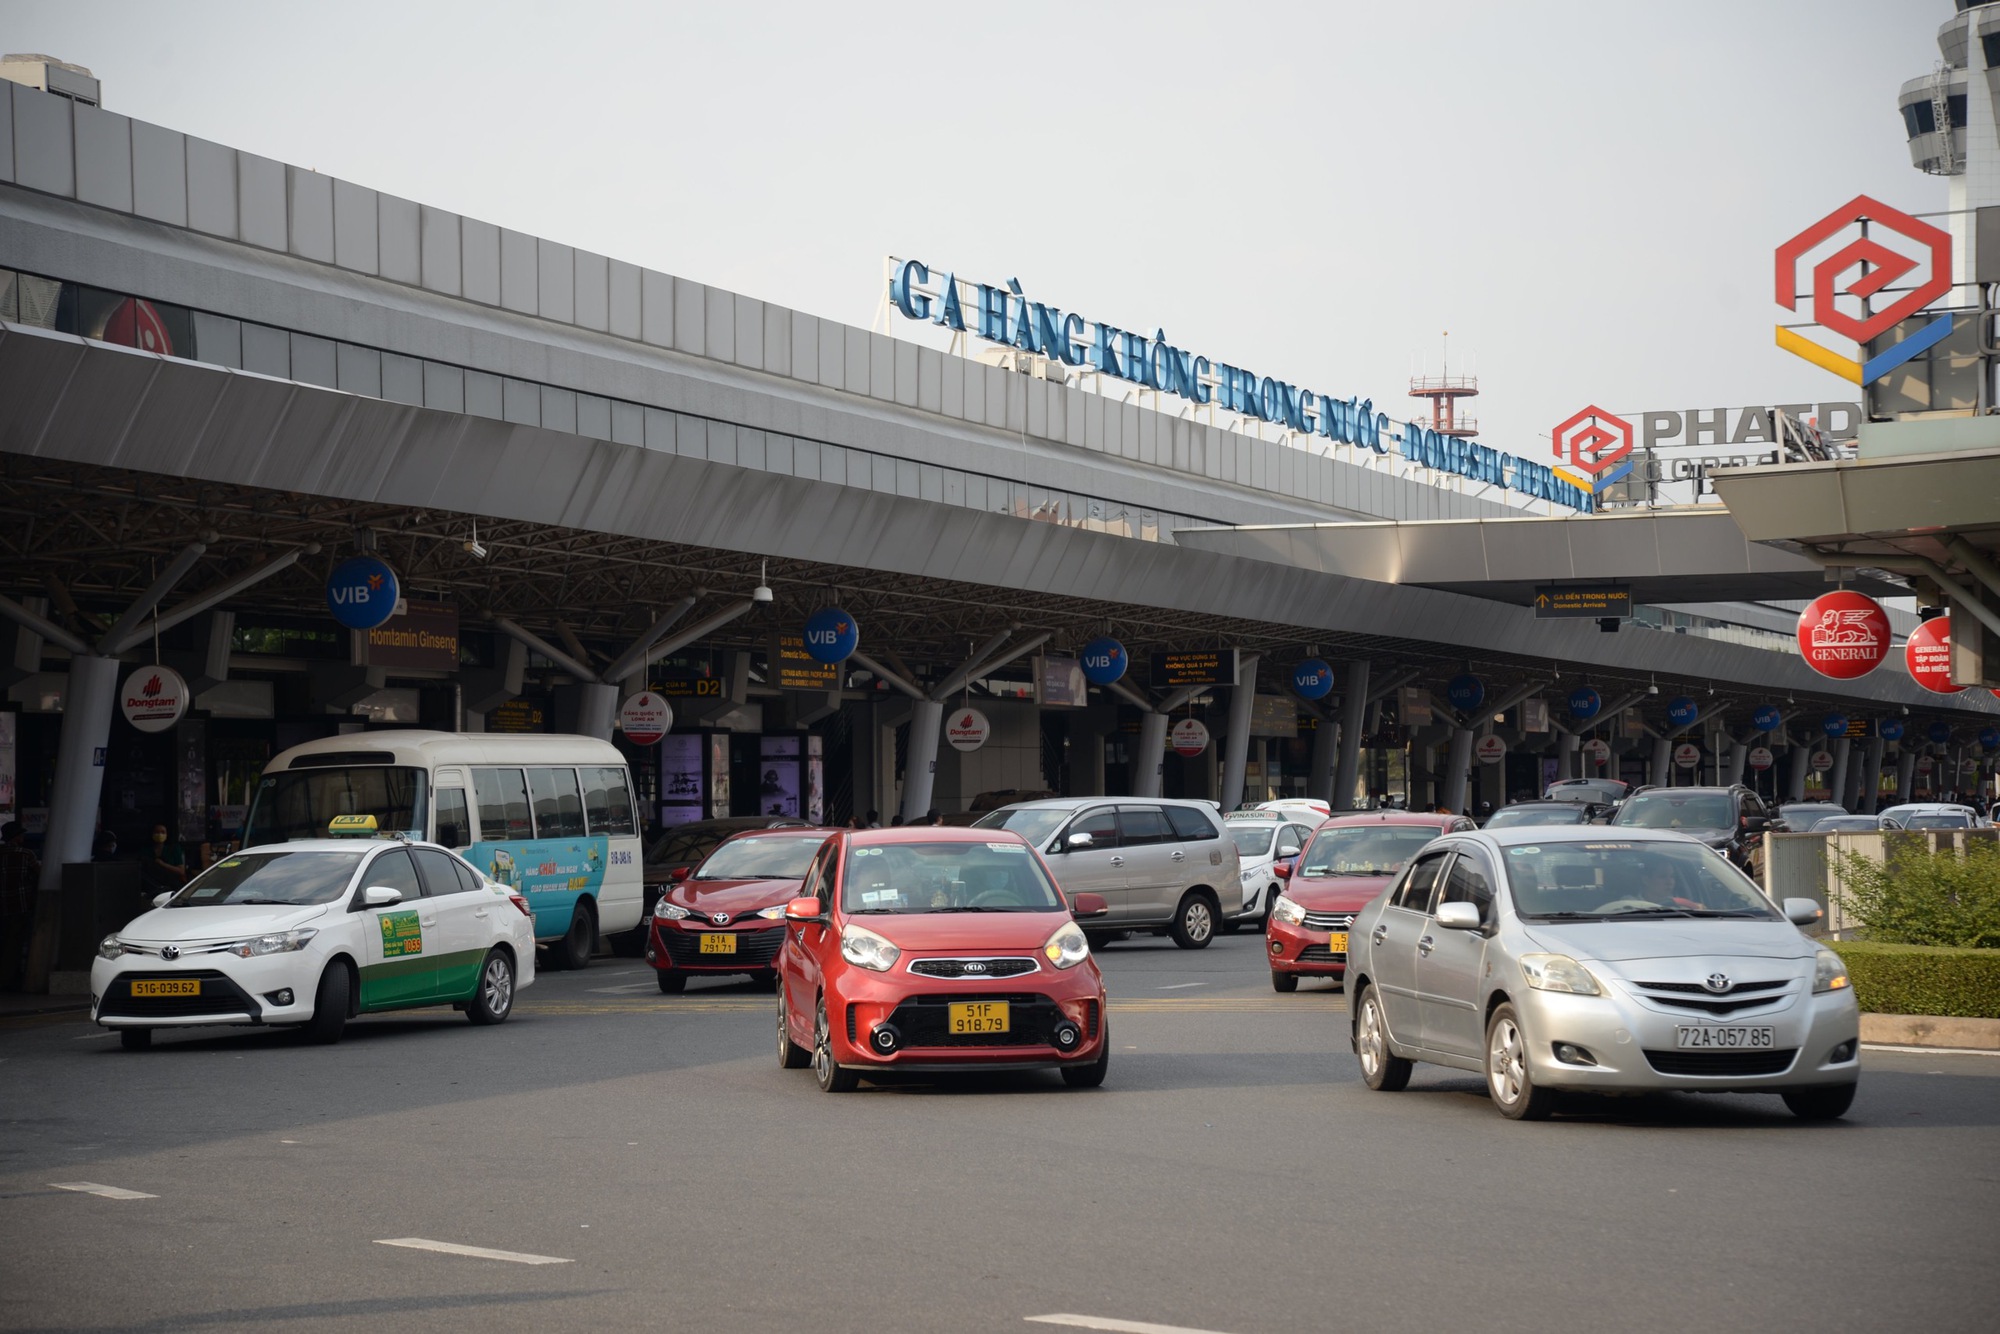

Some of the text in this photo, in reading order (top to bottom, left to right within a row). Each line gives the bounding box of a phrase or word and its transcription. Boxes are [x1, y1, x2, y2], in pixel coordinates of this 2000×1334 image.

[890, 258, 967, 332] GA
[975, 276, 1085, 367] HÀNG
[1090, 322, 1214, 404] KHÔNG
[1214, 363, 1316, 434] TRONG
[1318, 394, 1390, 455] NƯỚC
[1400, 422, 1513, 490] DOMESTIC
[331, 586, 370, 605] VIB
[1583, 592, 1606, 600] TRONG
[369, 628, 457, 654] Homtamin Ginseng
[808, 630, 838, 645] VIB
[1812, 647, 1879, 661] GENERALI
[1914, 645, 1949, 654] GENERALI
[1085, 656, 1111, 670] VIB
[1914, 654, 1928, 663] TẬP
[1165, 660, 1186, 670] KHÔNG
[1204, 659, 1219, 668] PHÚT
[1915, 662, 1930, 673] BẢO
[1188, 669, 1207, 678] Parking
[1296, 674, 1319, 687] VIB
[697, 679, 720, 696] D2
[1451, 688, 1471, 699] VIB
[127, 698, 175, 709] Dongtam
[1571, 698, 1589, 709] VIB
[639, 709, 654, 717] QUỐC
[1669, 709, 1688, 718] VIB
[1754, 715, 1772, 725] VIB
[1824, 721, 1840, 731] VIB
[1880, 727, 1896, 736] VIB
[949, 728, 983, 737] Dongtam
[1232, 811, 1265, 819] VINASUN
[710, 935, 727, 944] 61A
[403, 938, 422, 953] 1055
[703, 943, 732, 953] 791.71
[968, 963, 983, 971] KIA
[136, 982, 195, 994] 51G-039.62
[966, 1004, 992, 1018] 51F
[956, 1017, 1003, 1032] 918.79
[1680, 1027, 1771, 1047] 72A-057.85
